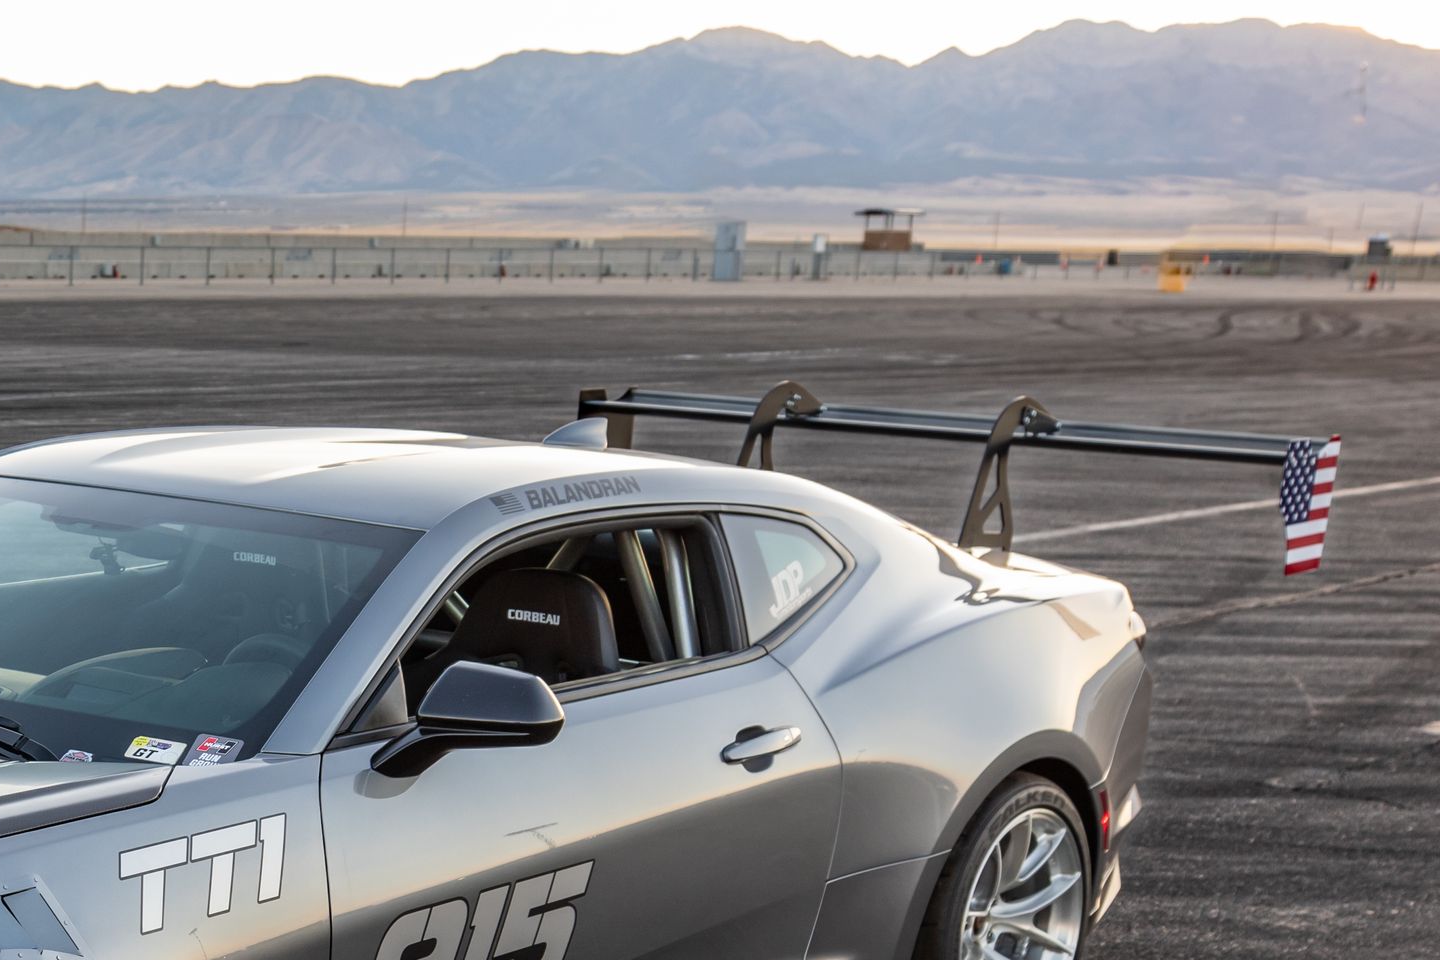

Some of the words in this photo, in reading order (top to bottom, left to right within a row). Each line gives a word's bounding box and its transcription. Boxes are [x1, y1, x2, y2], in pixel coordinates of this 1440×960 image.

[524, 475, 642, 510] BALANDRAN
[232, 551, 277, 567] CORBEAU
[506, 608, 561, 626] CORBEAU
[132, 747, 159, 759] GT
[198, 752, 222, 763] RUN
[118, 812, 287, 936] TT1
